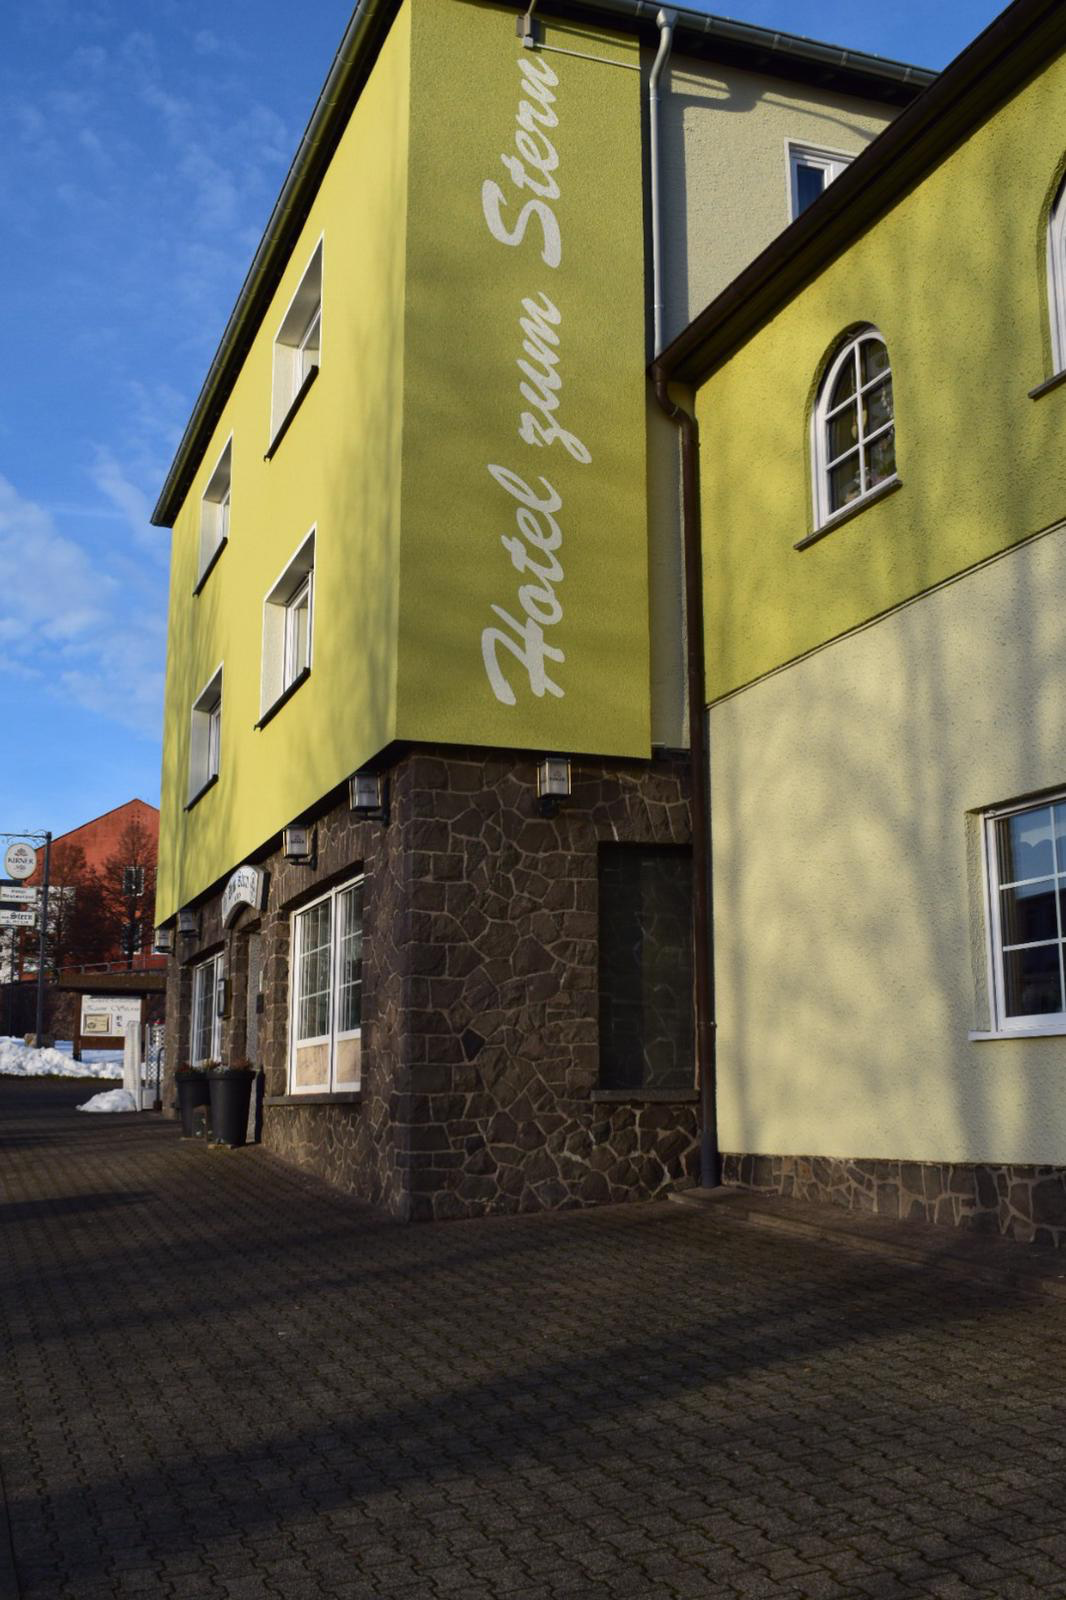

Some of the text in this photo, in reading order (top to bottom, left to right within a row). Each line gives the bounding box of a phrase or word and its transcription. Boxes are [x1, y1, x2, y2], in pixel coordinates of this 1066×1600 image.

[480, 56, 593, 707] Hotel zum Stern
[10, 911, 33, 921] Stern
